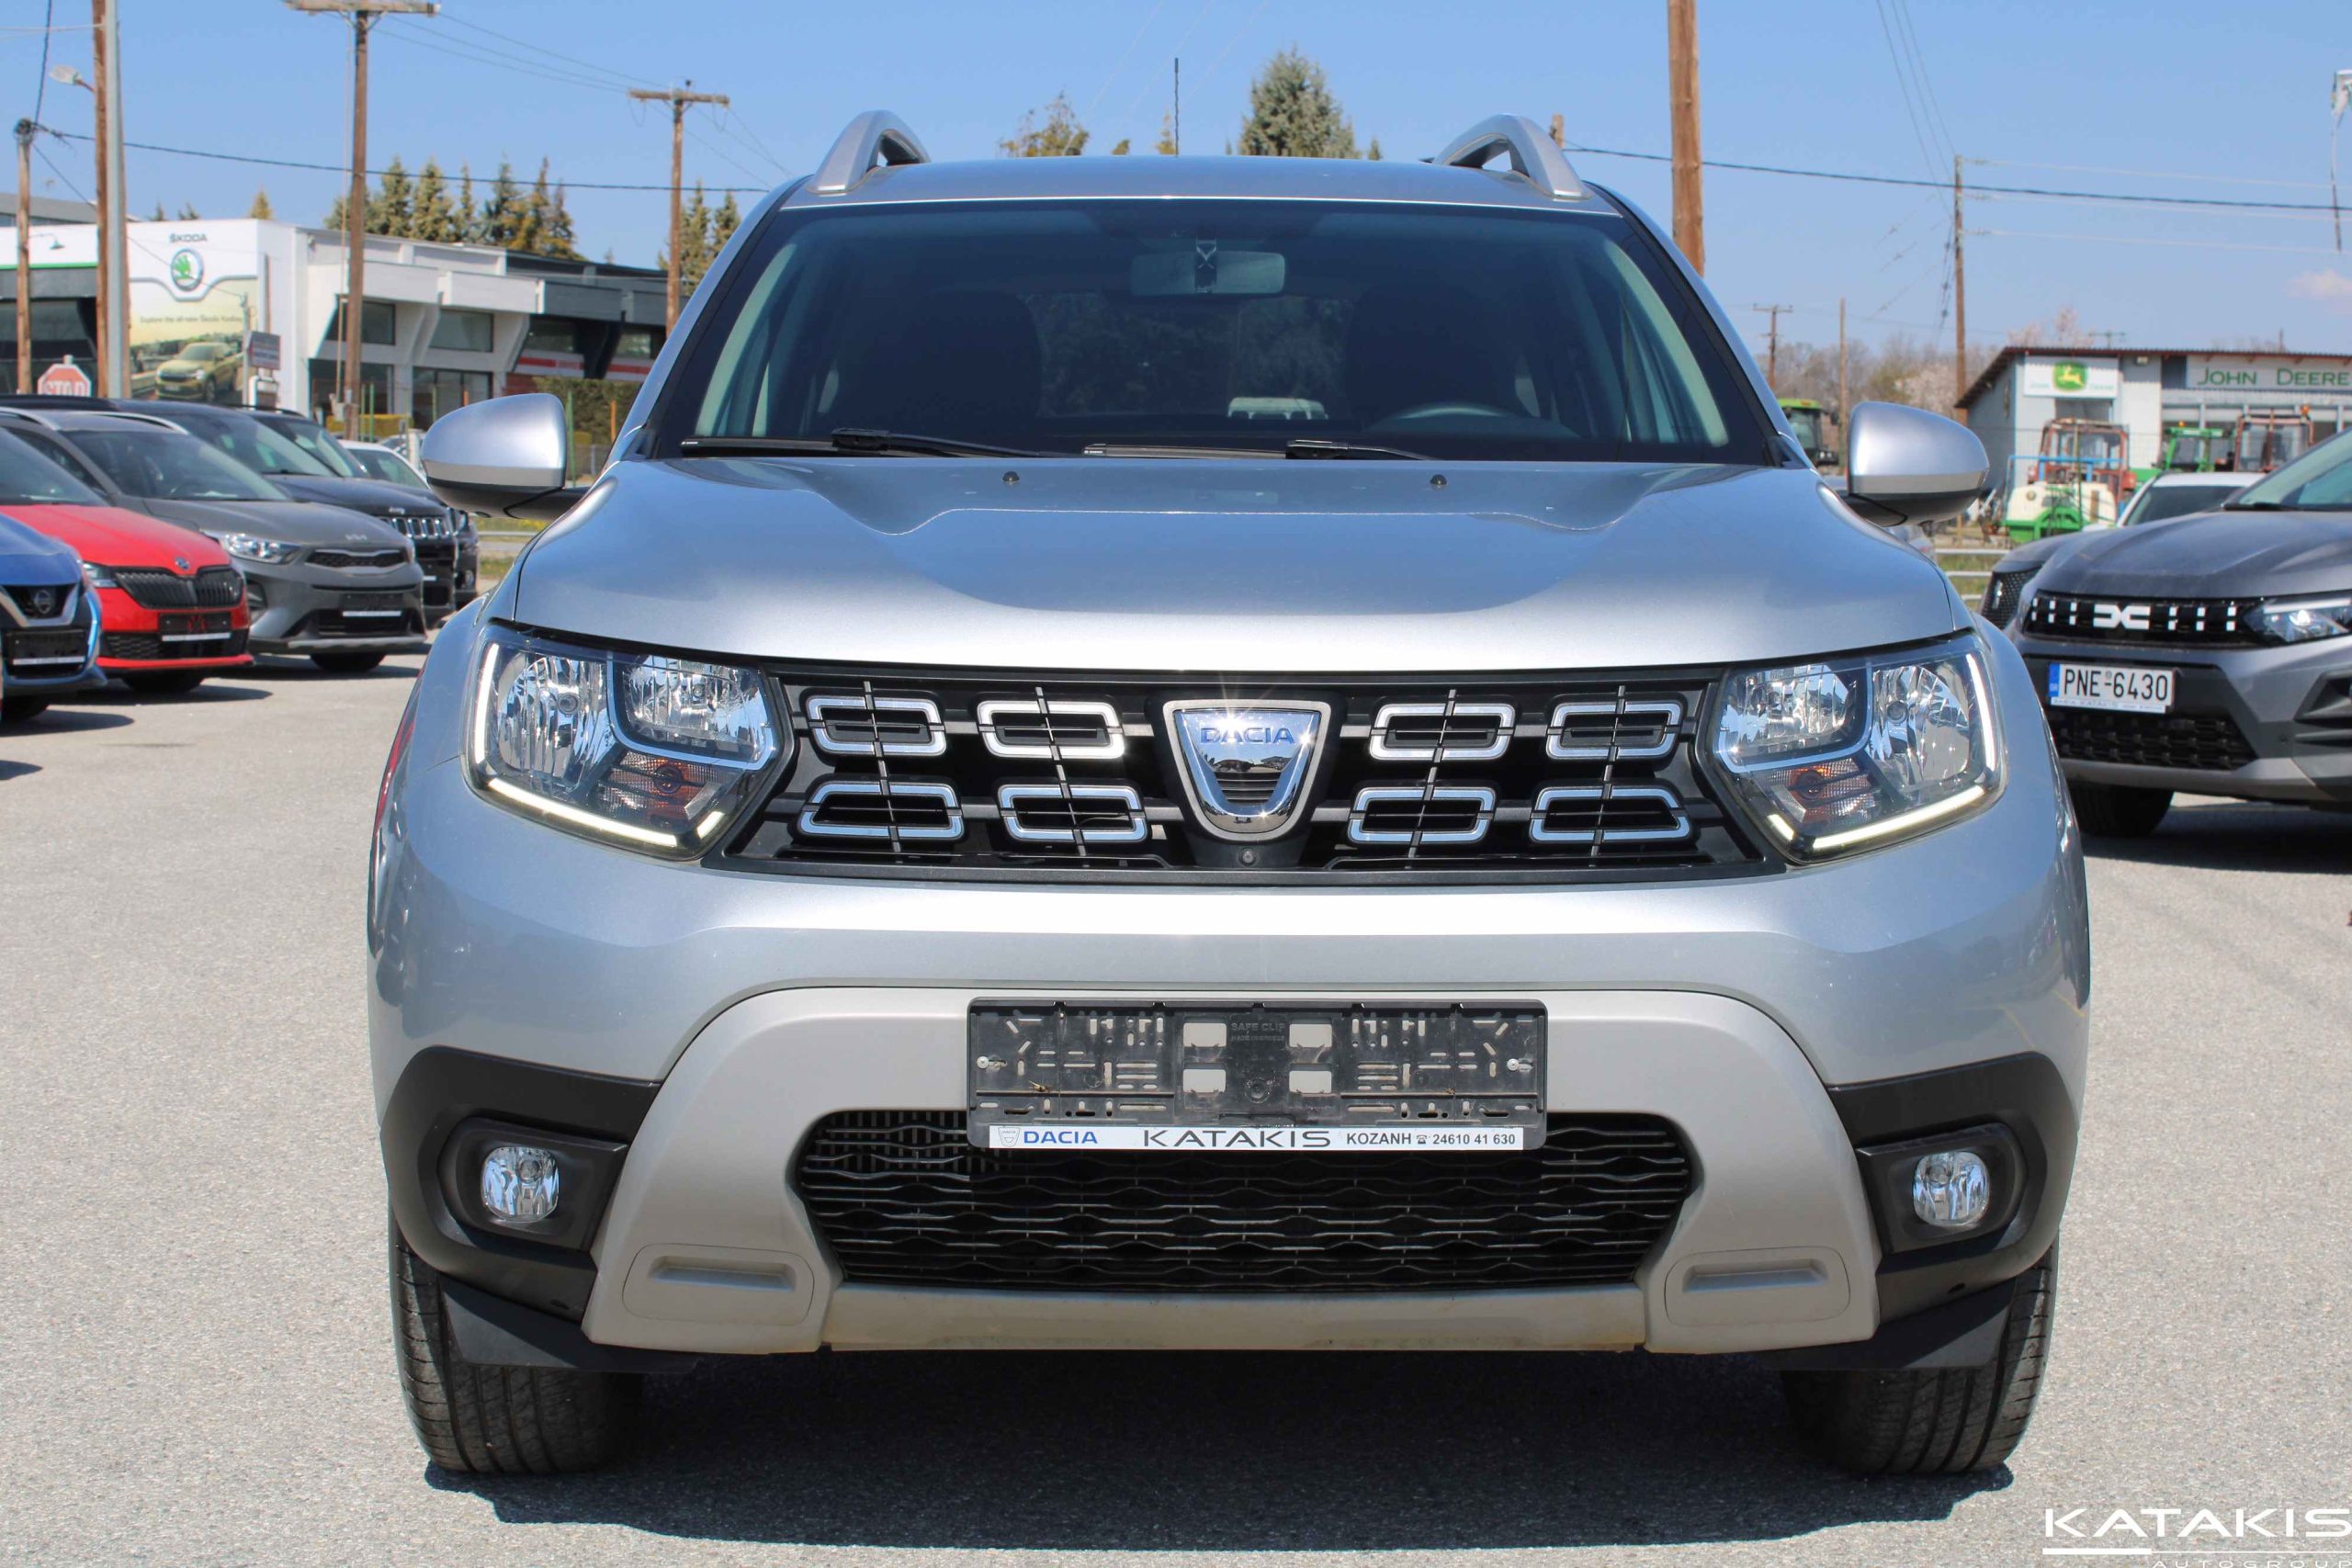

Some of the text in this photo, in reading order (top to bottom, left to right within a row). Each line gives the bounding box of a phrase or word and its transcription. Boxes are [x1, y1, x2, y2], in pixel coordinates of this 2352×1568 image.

[2198, 367, 2350, 386] JOHN DEERE
[1200, 728, 1295, 743] DACIA
[1023, 1131, 1098, 1144] DACIA
[1144, 1130, 1331, 1147] KATAKIS
[1432, 1134, 1470, 1145] 24610
[1474, 1134, 1488, 1145] 41
[1493, 1134, 1516, 1145] 630
